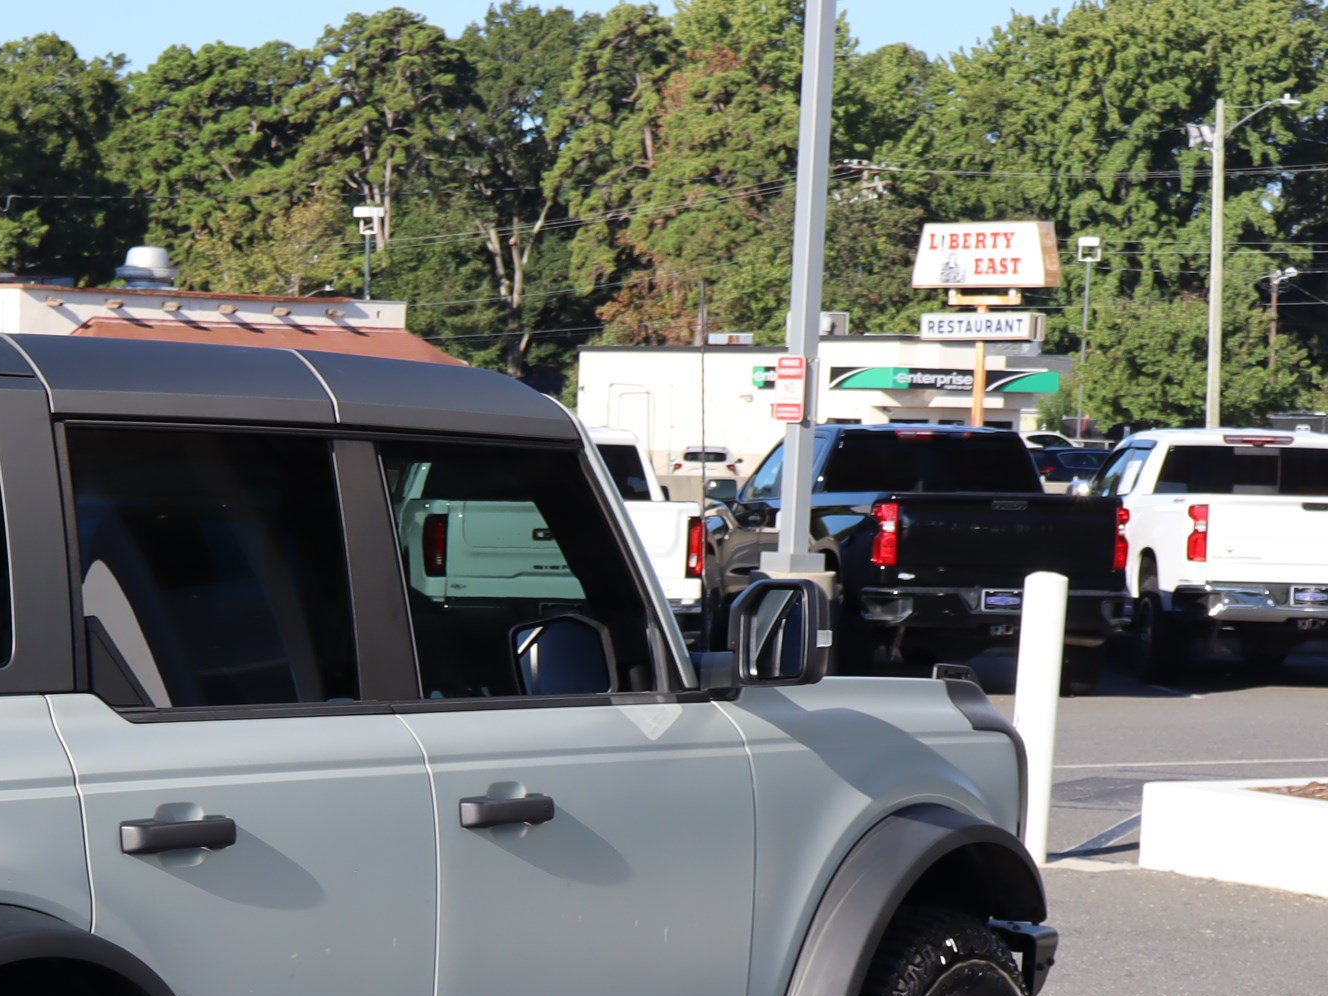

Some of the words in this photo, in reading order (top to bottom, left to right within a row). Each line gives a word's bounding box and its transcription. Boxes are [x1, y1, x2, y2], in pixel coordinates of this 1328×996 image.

[929, 232, 1016, 250] LIBERTY
[974, 257, 1022, 275] EAST
[928, 318, 1024, 334] RESTAURANT
[894, 372, 974, 387] enterprise
